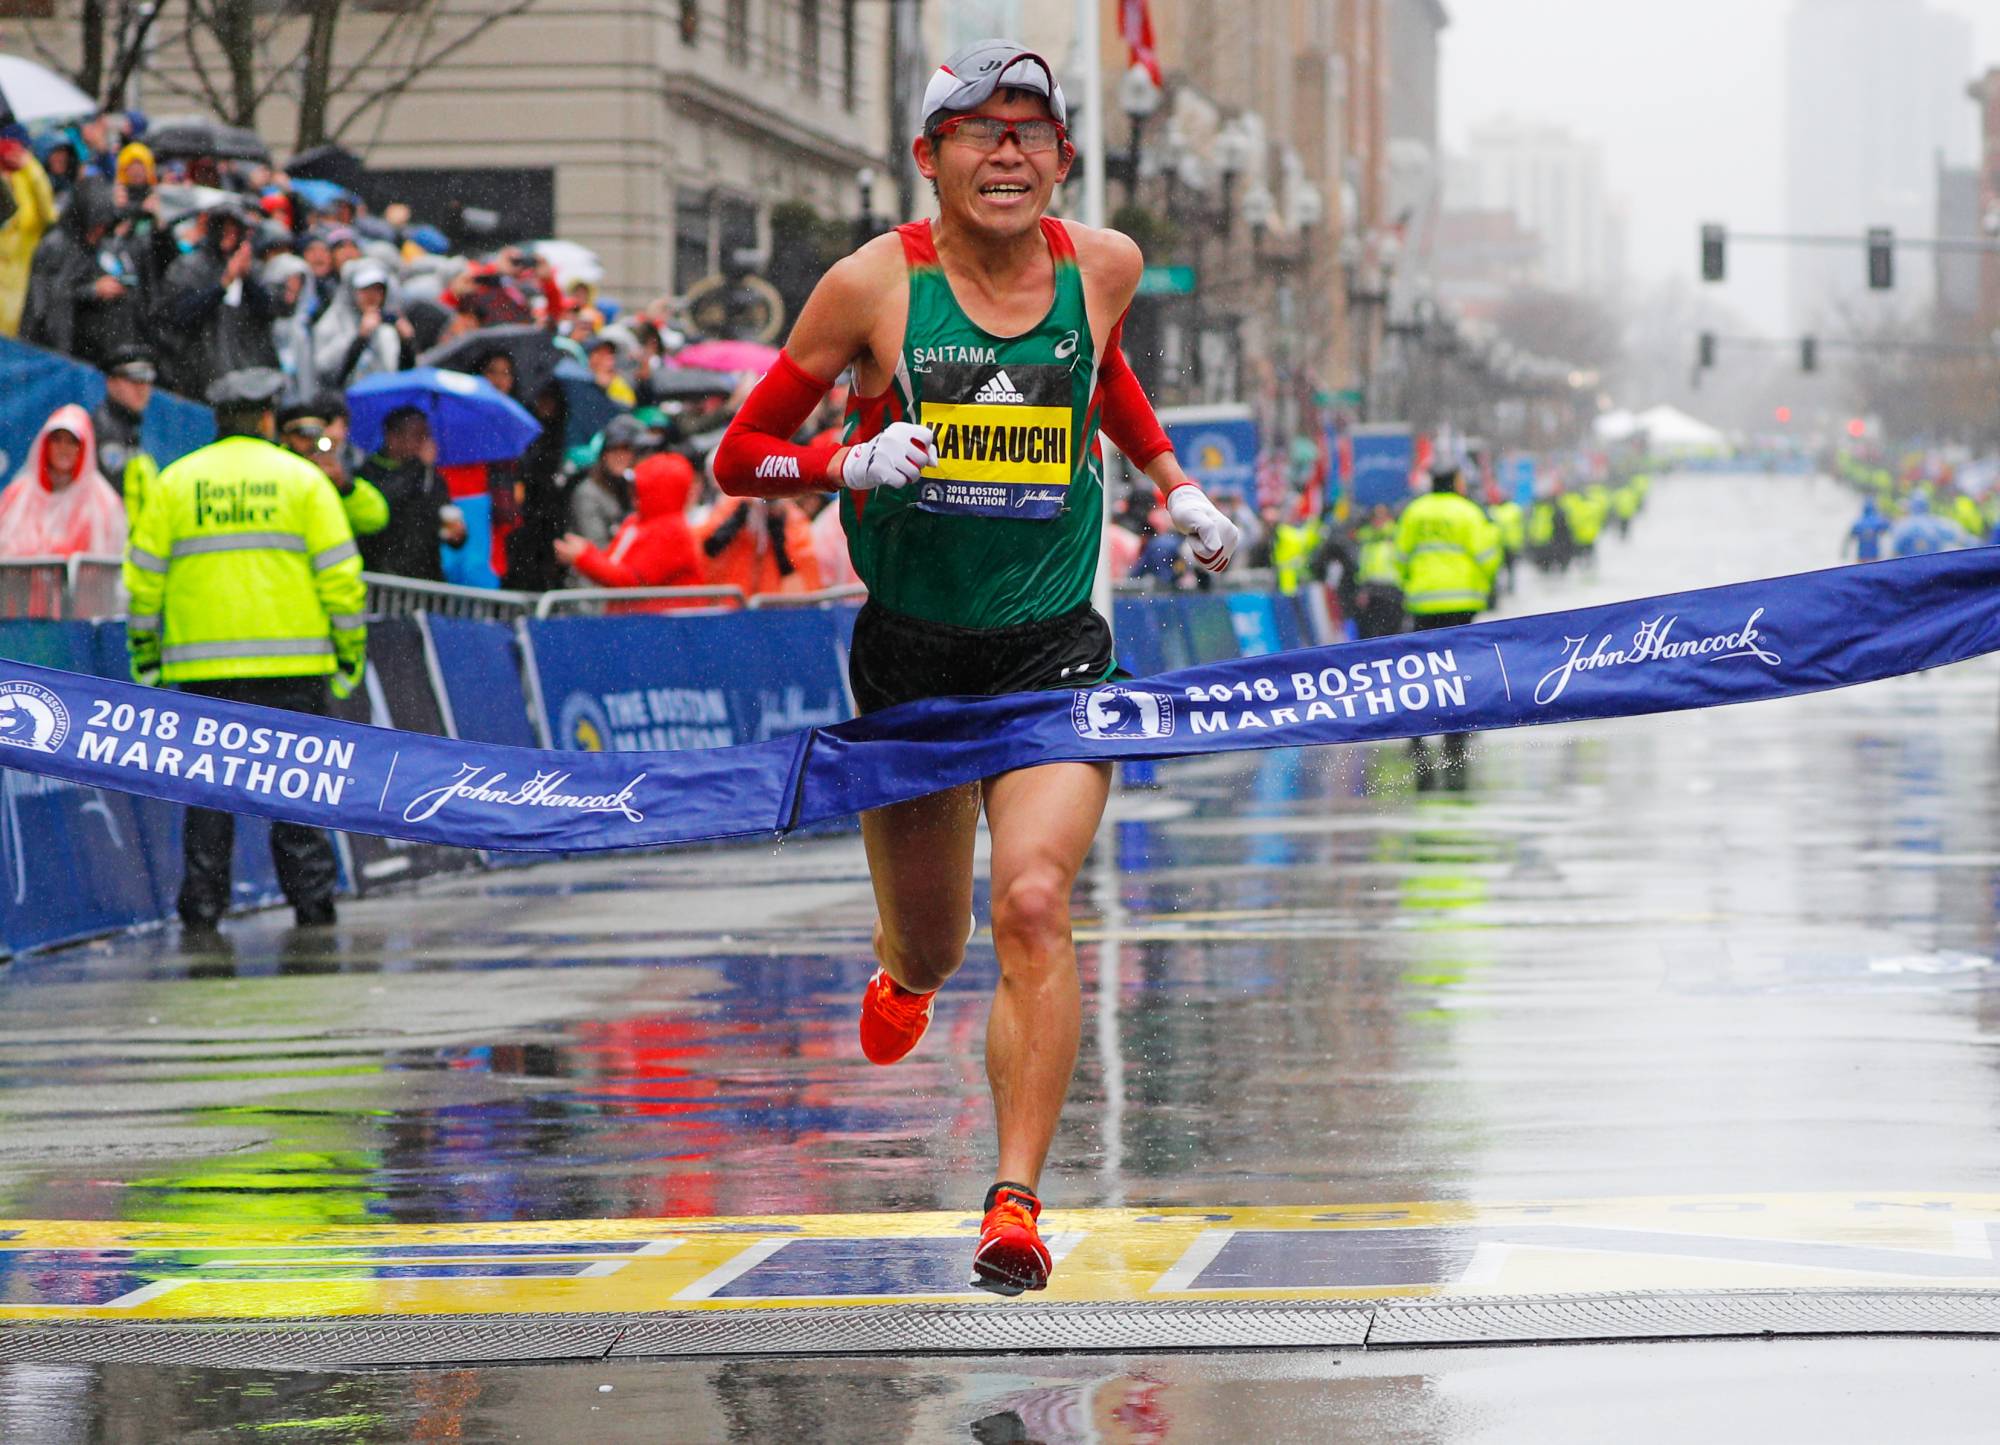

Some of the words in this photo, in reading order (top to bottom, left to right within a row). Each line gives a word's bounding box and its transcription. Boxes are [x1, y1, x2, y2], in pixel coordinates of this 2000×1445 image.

[913, 345, 996, 364] SAITAMA
[975, 390, 1024, 403] adidas
[926, 421, 1066, 464] KAWAUCHI
[755, 454, 800, 478] JAPAN
[195, 479, 277, 500] Boston
[946, 485, 967, 494] 2018
[969, 486, 1006, 496] BOSTON
[946, 494, 1006, 507] MARATHON
[197, 502, 277, 526] Police
[1290, 649, 1458, 701] BOSTON
[1189, 675, 1466, 735] MARATHON
[40, 692, 67, 747] ASSOCIATION
[87, 699, 181, 741] 2018
[191, 717, 356, 770] BOSTON
[76, 731, 346, 806] MARATHON
